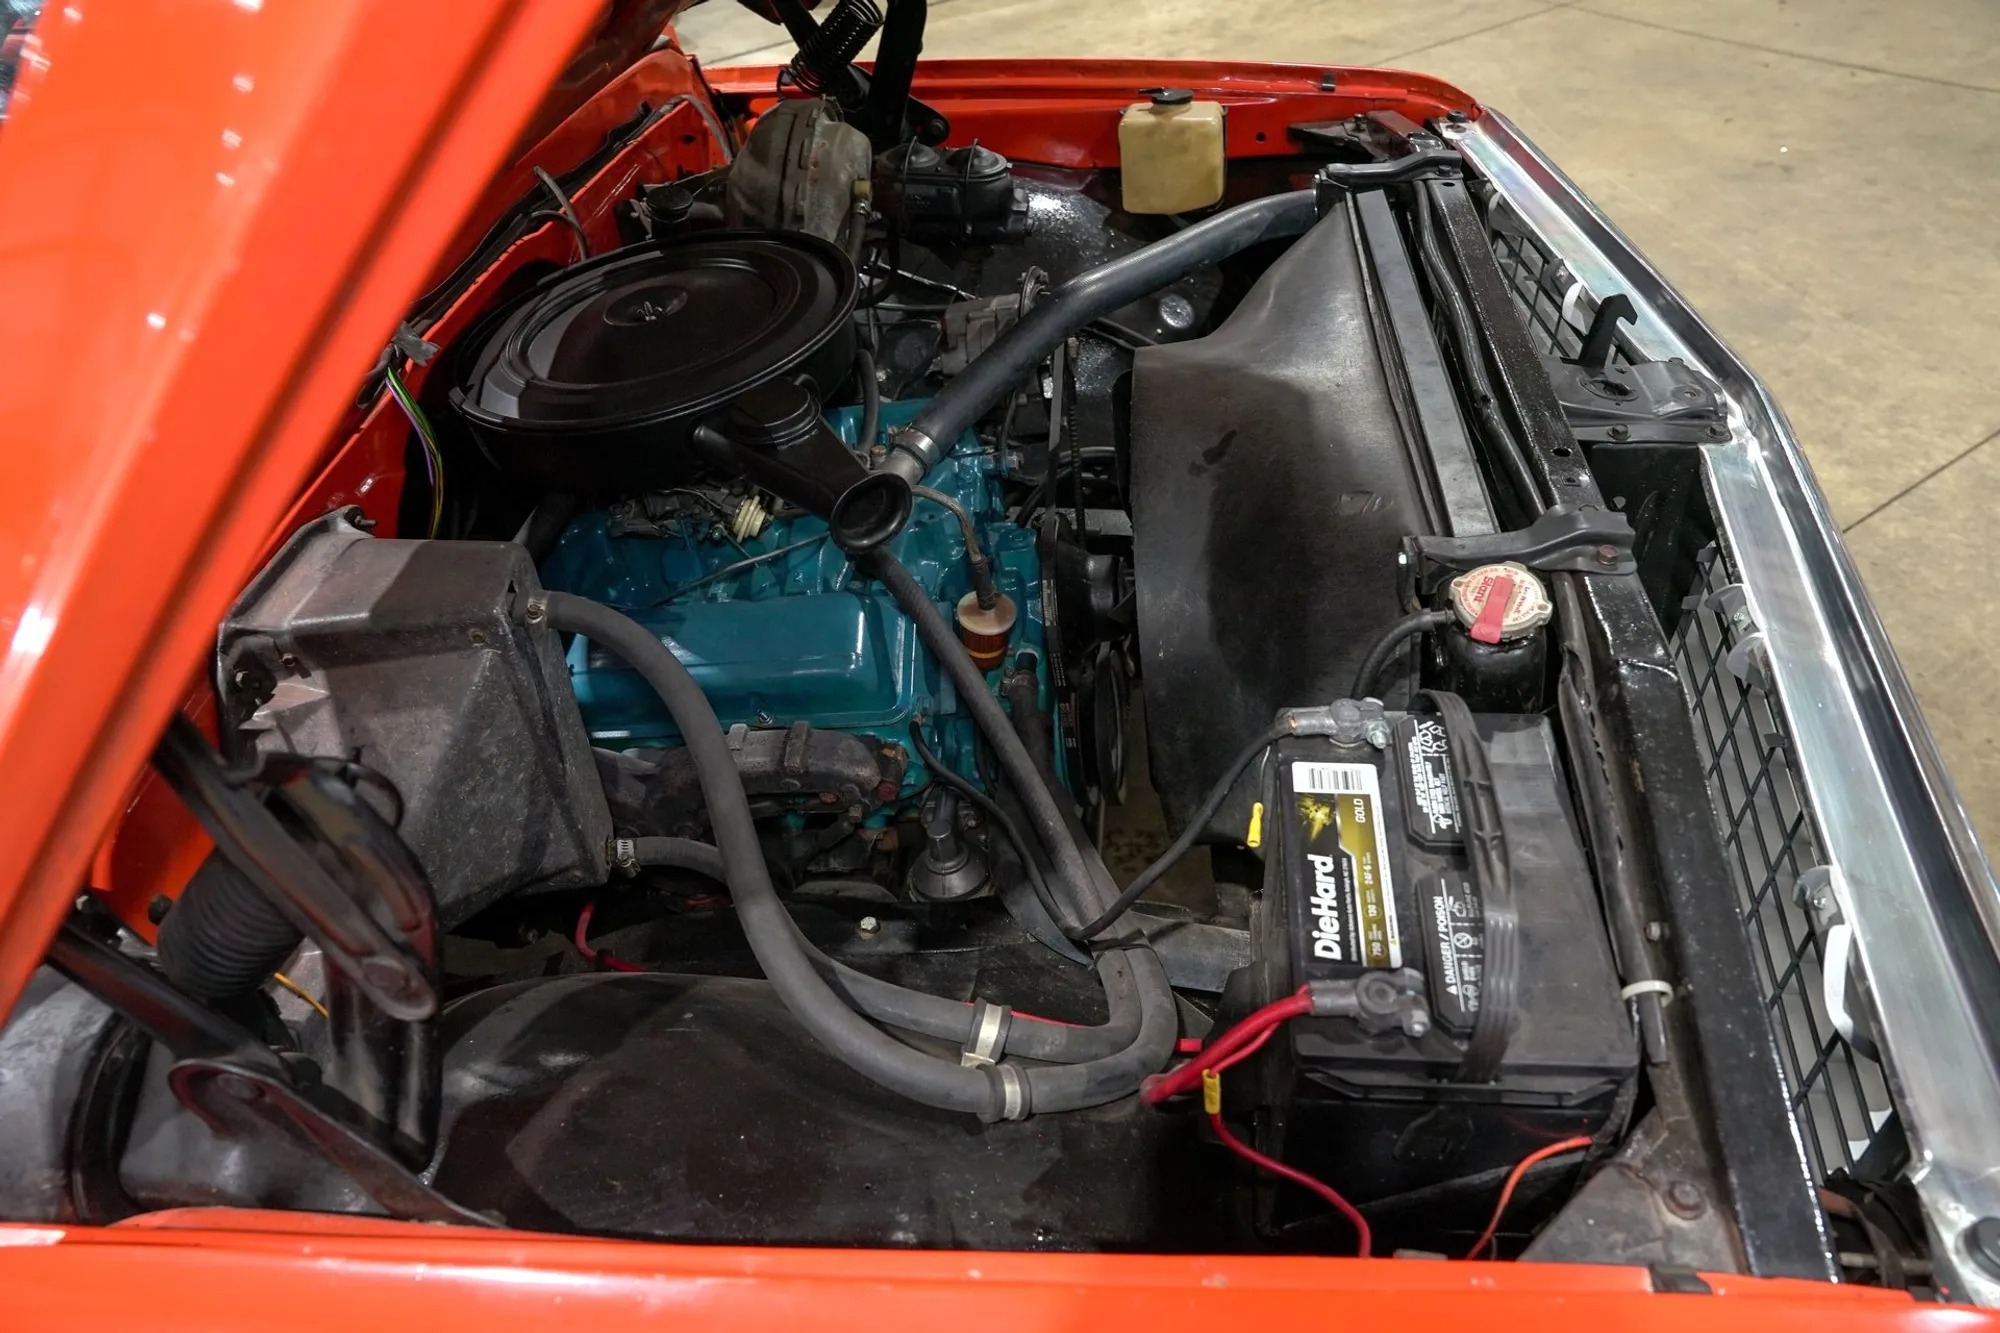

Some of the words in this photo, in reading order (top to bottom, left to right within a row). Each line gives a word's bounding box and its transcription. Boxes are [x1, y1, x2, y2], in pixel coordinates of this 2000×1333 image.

[1473, 576, 1494, 603] Stant
[1353, 798, 1366, 823] GOLD
[1306, 853, 1342, 961] DieHard
[1433, 895, 1449, 932] POISON
[1440, 941, 1456, 984] DANGER
